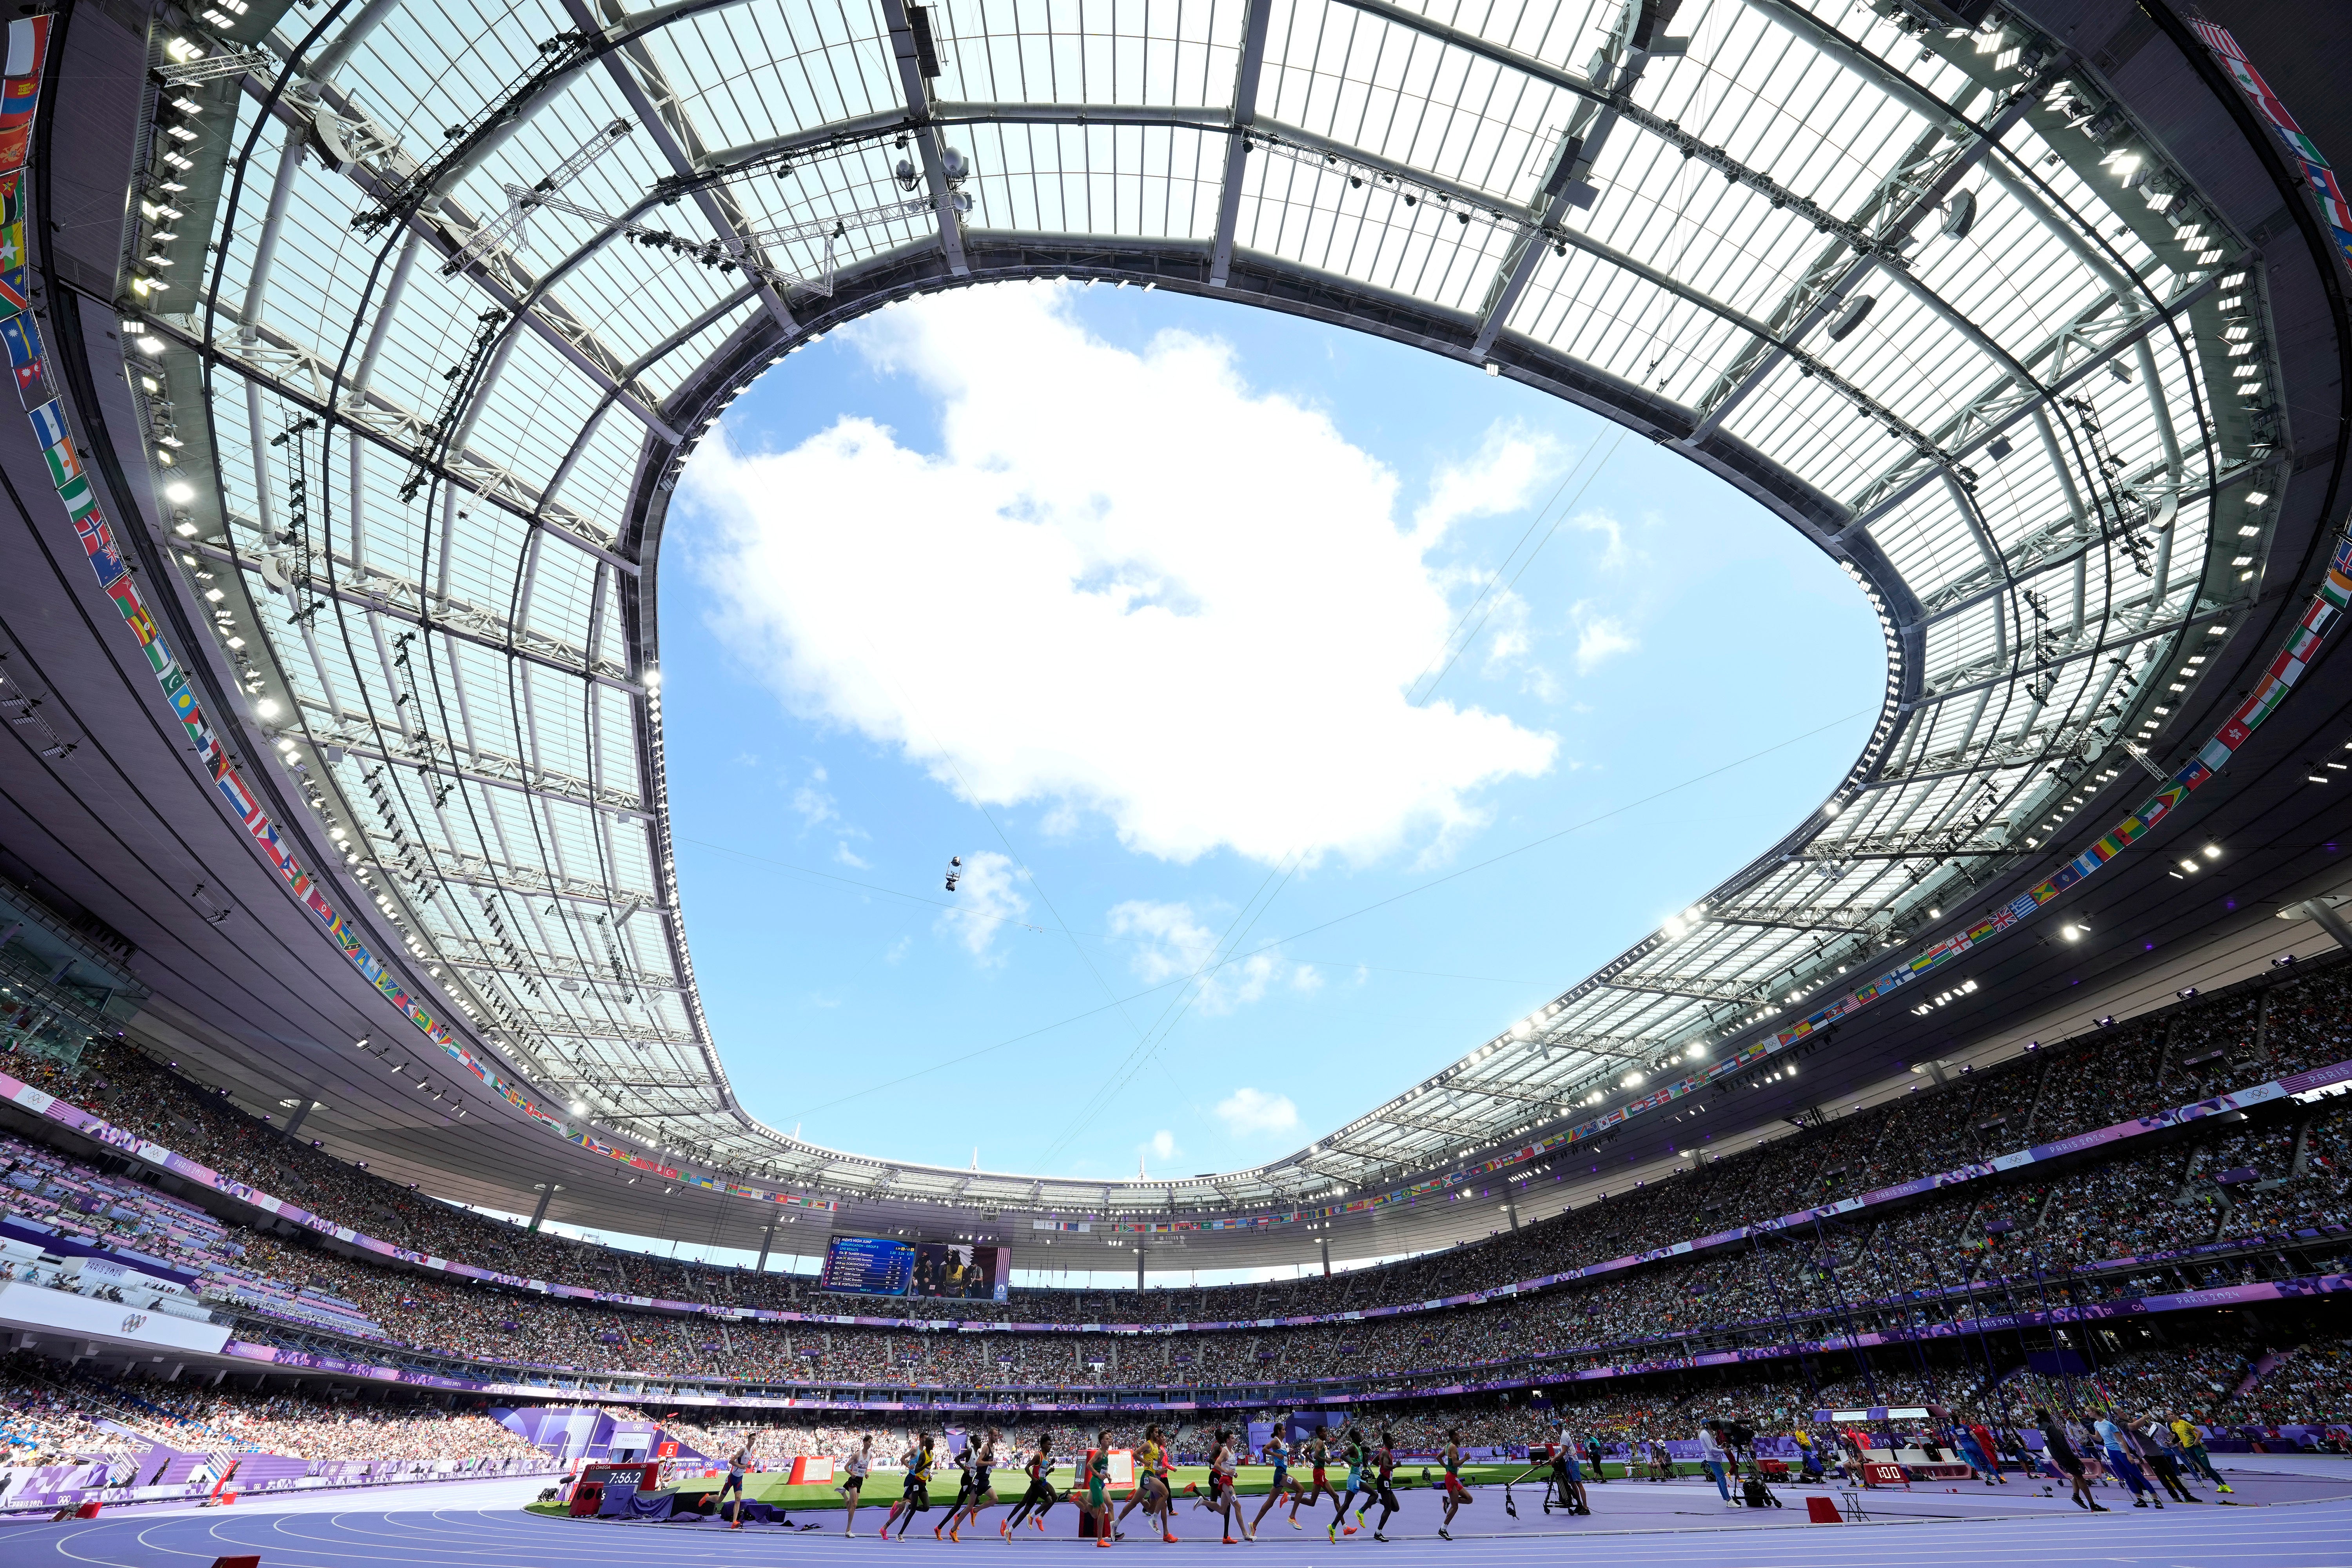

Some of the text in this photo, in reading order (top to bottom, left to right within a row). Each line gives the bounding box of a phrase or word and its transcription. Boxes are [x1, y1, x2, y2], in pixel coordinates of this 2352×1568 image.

[2049, 1133, 2105, 1153] PARIS 2024
[174, 1159, 206, 1178] PARIS 2024
[1876, 1185, 1918, 1200] PARIS 2024
[361, 1238, 374, 1246] PARIS
[84, 1262, 122, 1277] PARIS 2024
[2176, 1291, 2239, 1304] PARIS 2024
[666, 1445, 674, 1454] 6
[345, 1465, 359, 1474] PARIS
[1877, 1466, 1900, 1479] 1:00
[609, 1472, 641, 1483] 7:56.2
